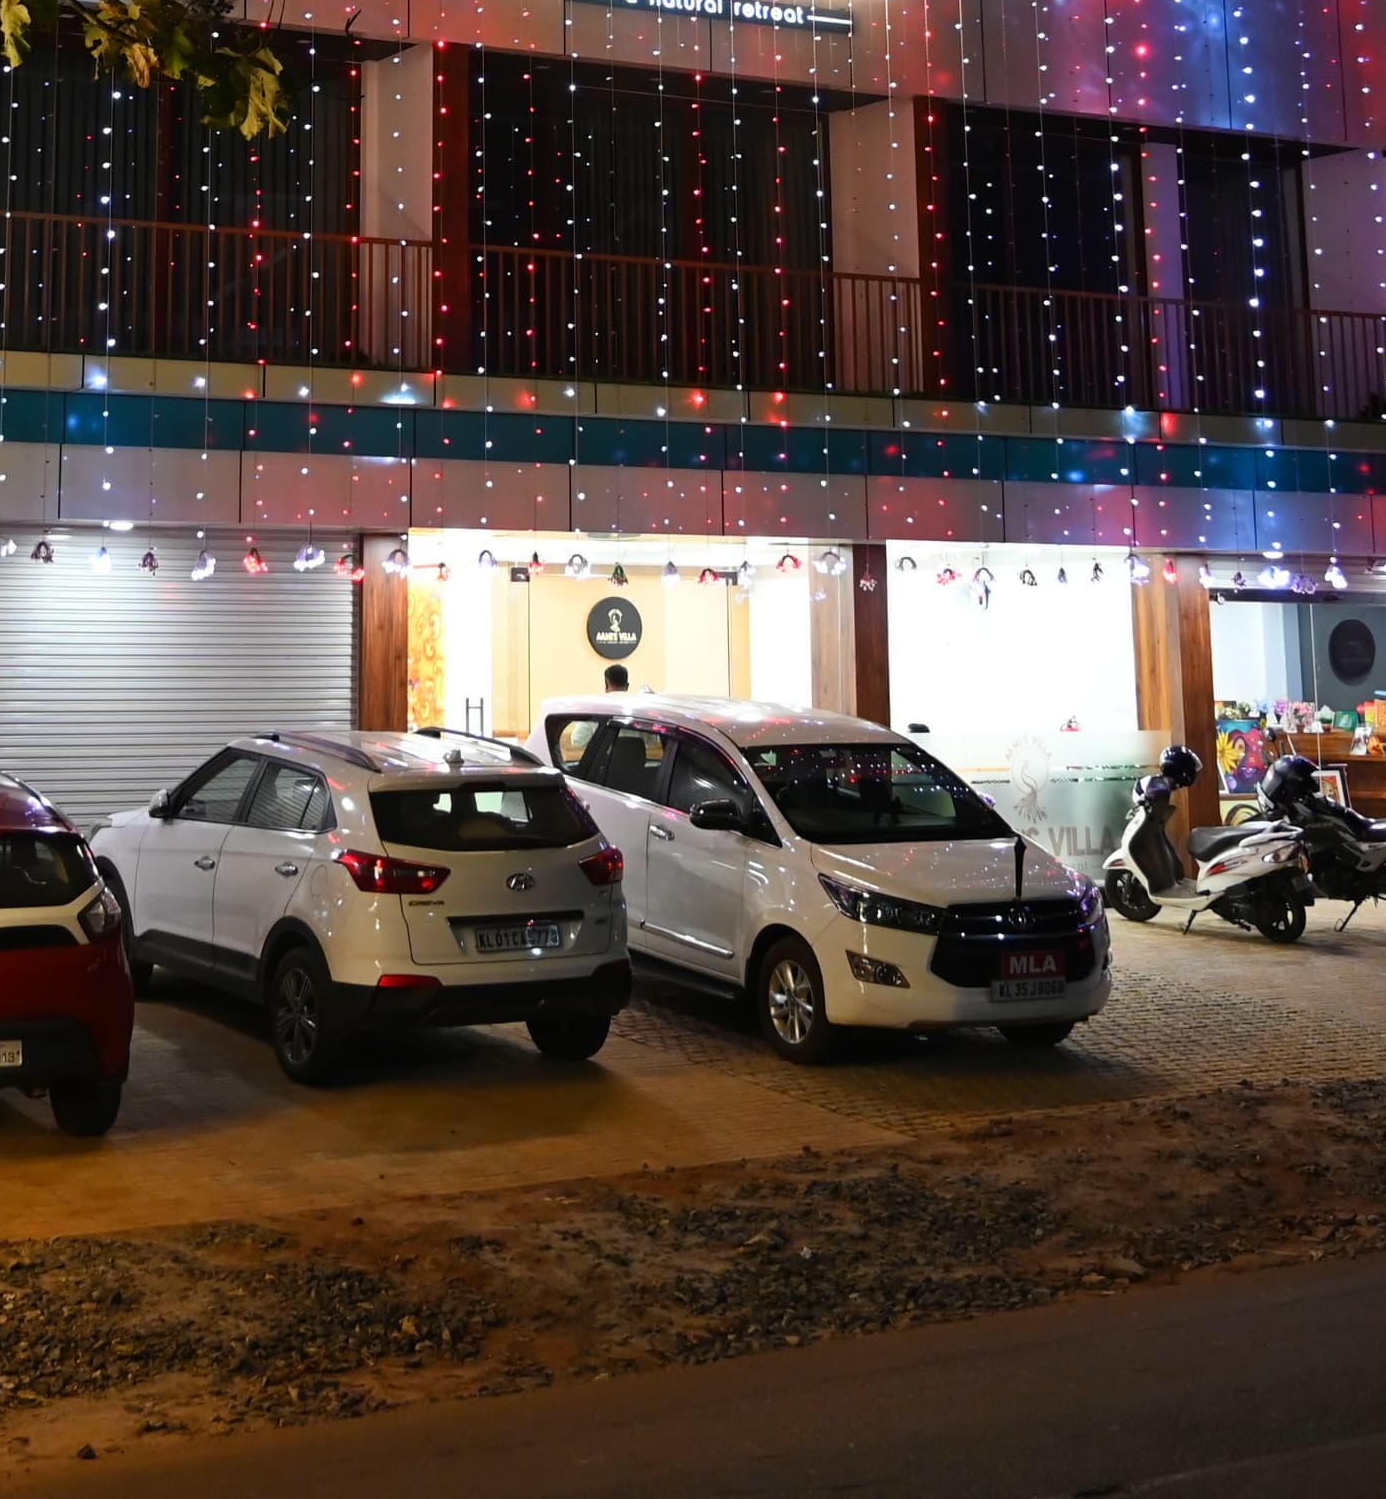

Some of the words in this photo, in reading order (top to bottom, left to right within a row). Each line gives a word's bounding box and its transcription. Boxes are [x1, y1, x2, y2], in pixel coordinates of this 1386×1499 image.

[1048, 826, 1118, 857] VILLA
[1009, 954, 1057, 974] MLA
[998, 982, 1012, 998] KL
